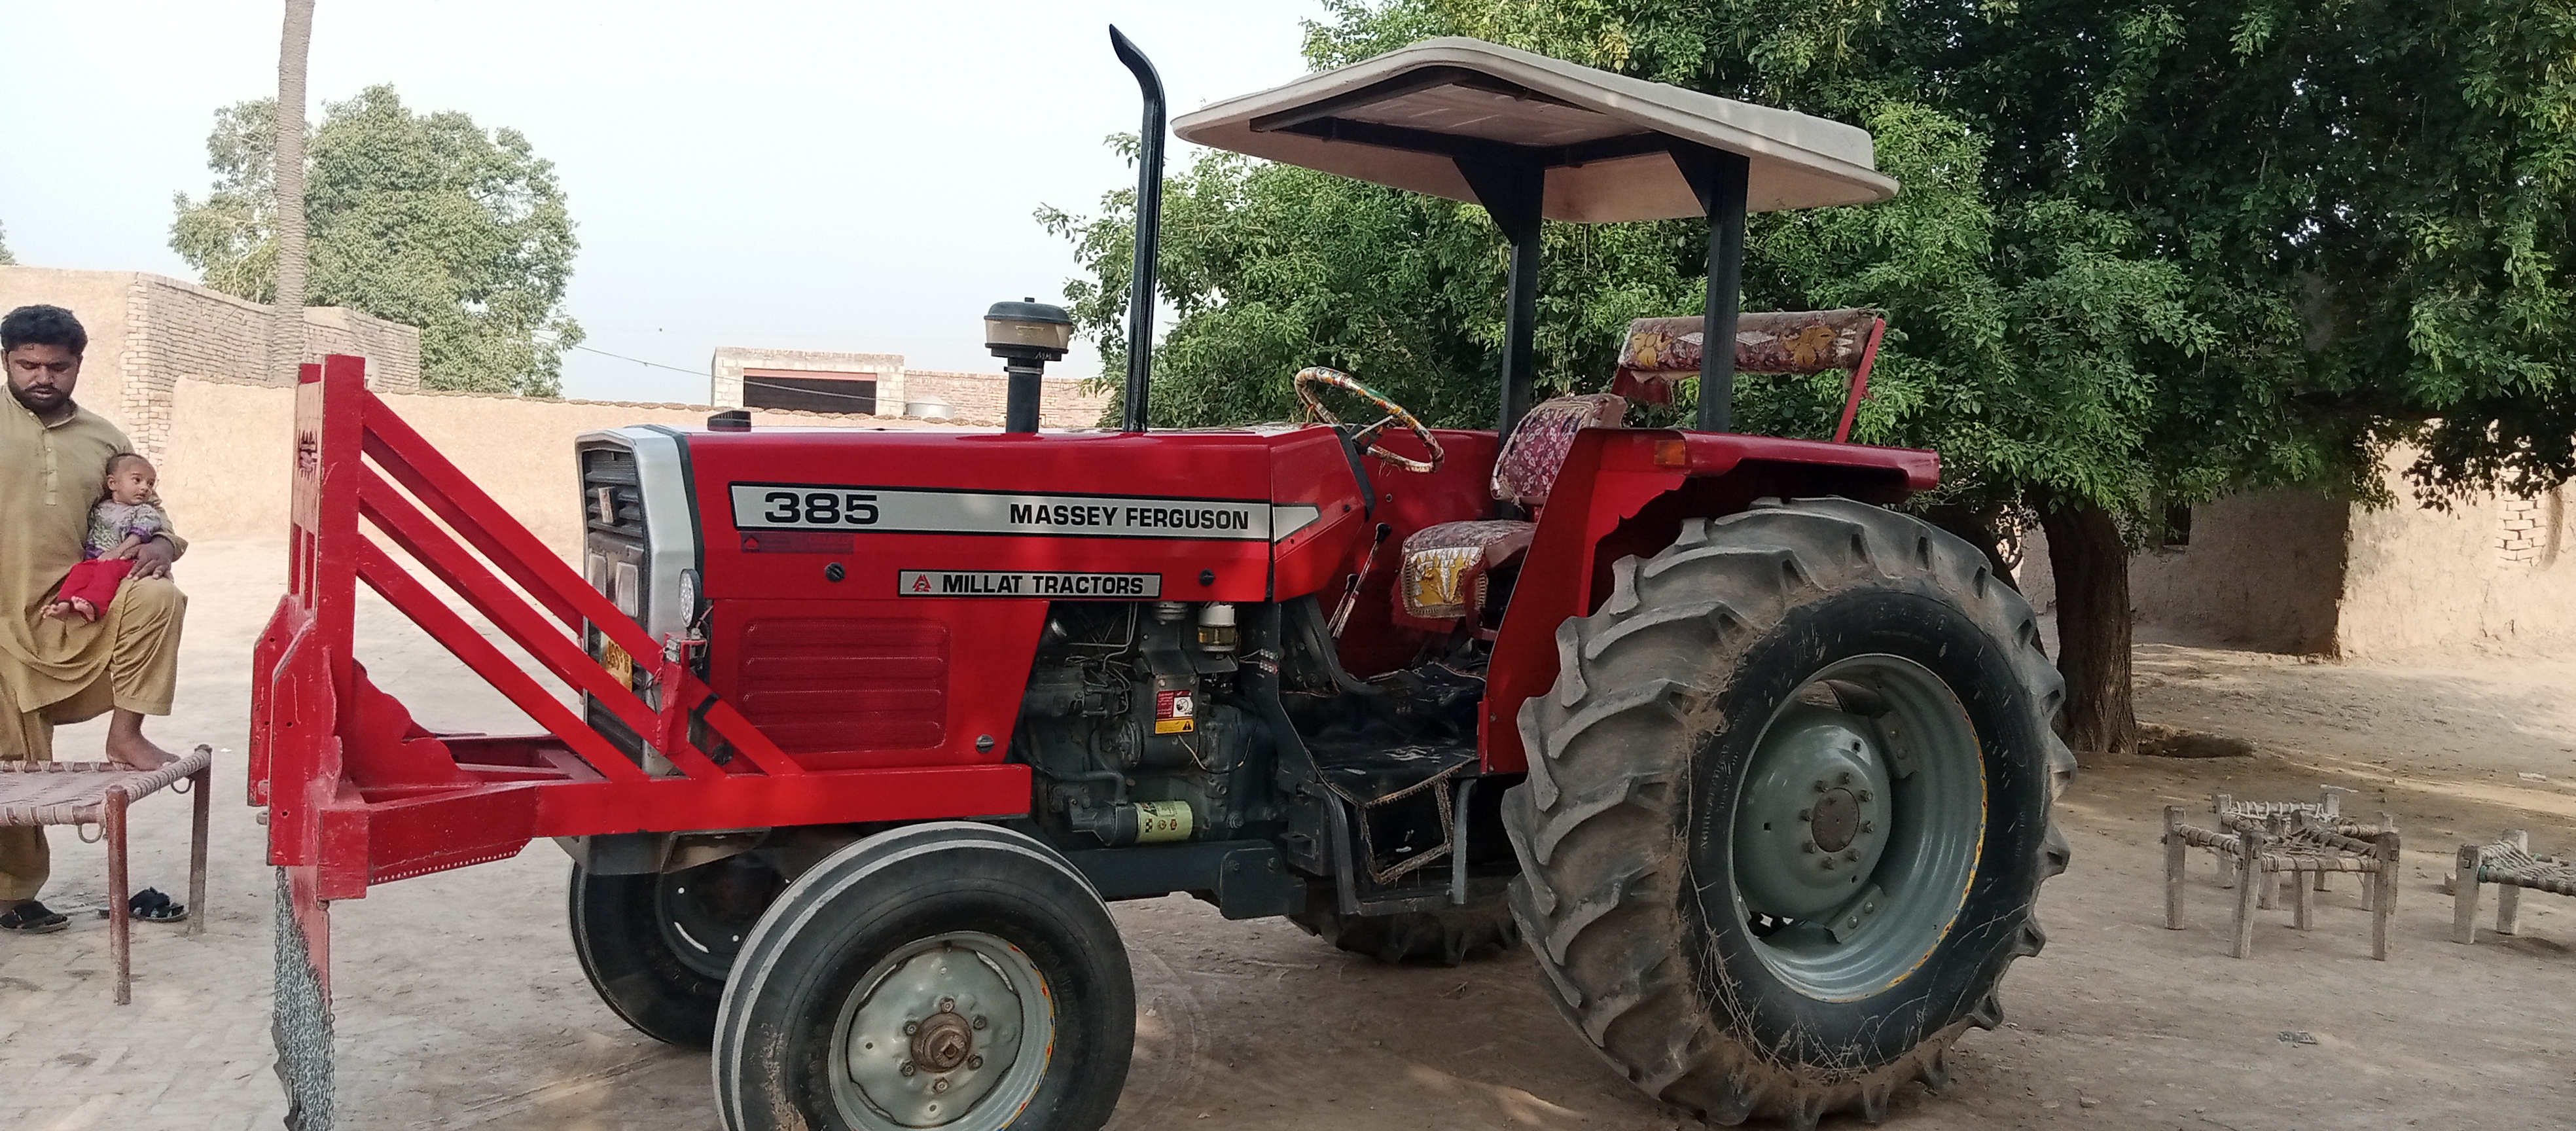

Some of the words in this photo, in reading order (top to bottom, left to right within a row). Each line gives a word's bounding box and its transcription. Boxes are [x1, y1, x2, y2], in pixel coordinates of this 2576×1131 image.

[764, 492, 879, 525] 385
[1010, 503, 1118, 526] MASSEY
[1126, 507, 1249, 530] FERGUSON
[942, 574, 1023, 594] MILLAT
[1032, 575, 1143, 594] TRACTORS
